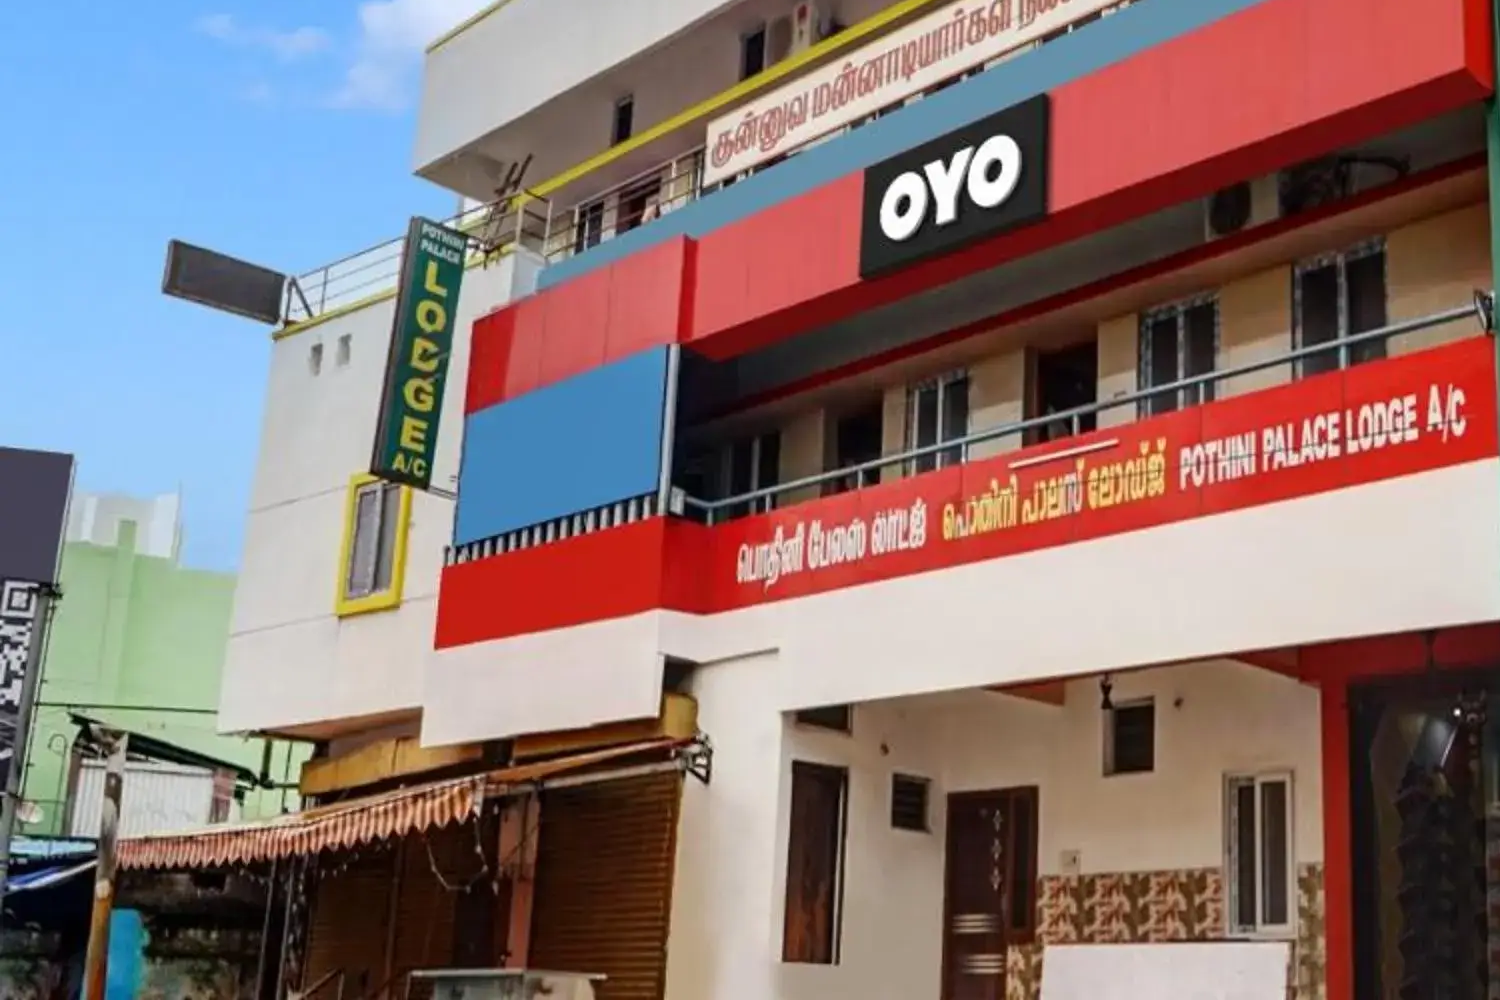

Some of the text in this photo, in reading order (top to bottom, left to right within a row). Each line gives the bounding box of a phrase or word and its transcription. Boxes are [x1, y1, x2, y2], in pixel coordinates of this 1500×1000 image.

[879, 134, 1023, 241] OYO
[400, 260, 448, 453] LODGE
[392, 452, 426, 478] A/C
[1180, 383, 1467, 490] POTHINI PALACE LODGE A/C
